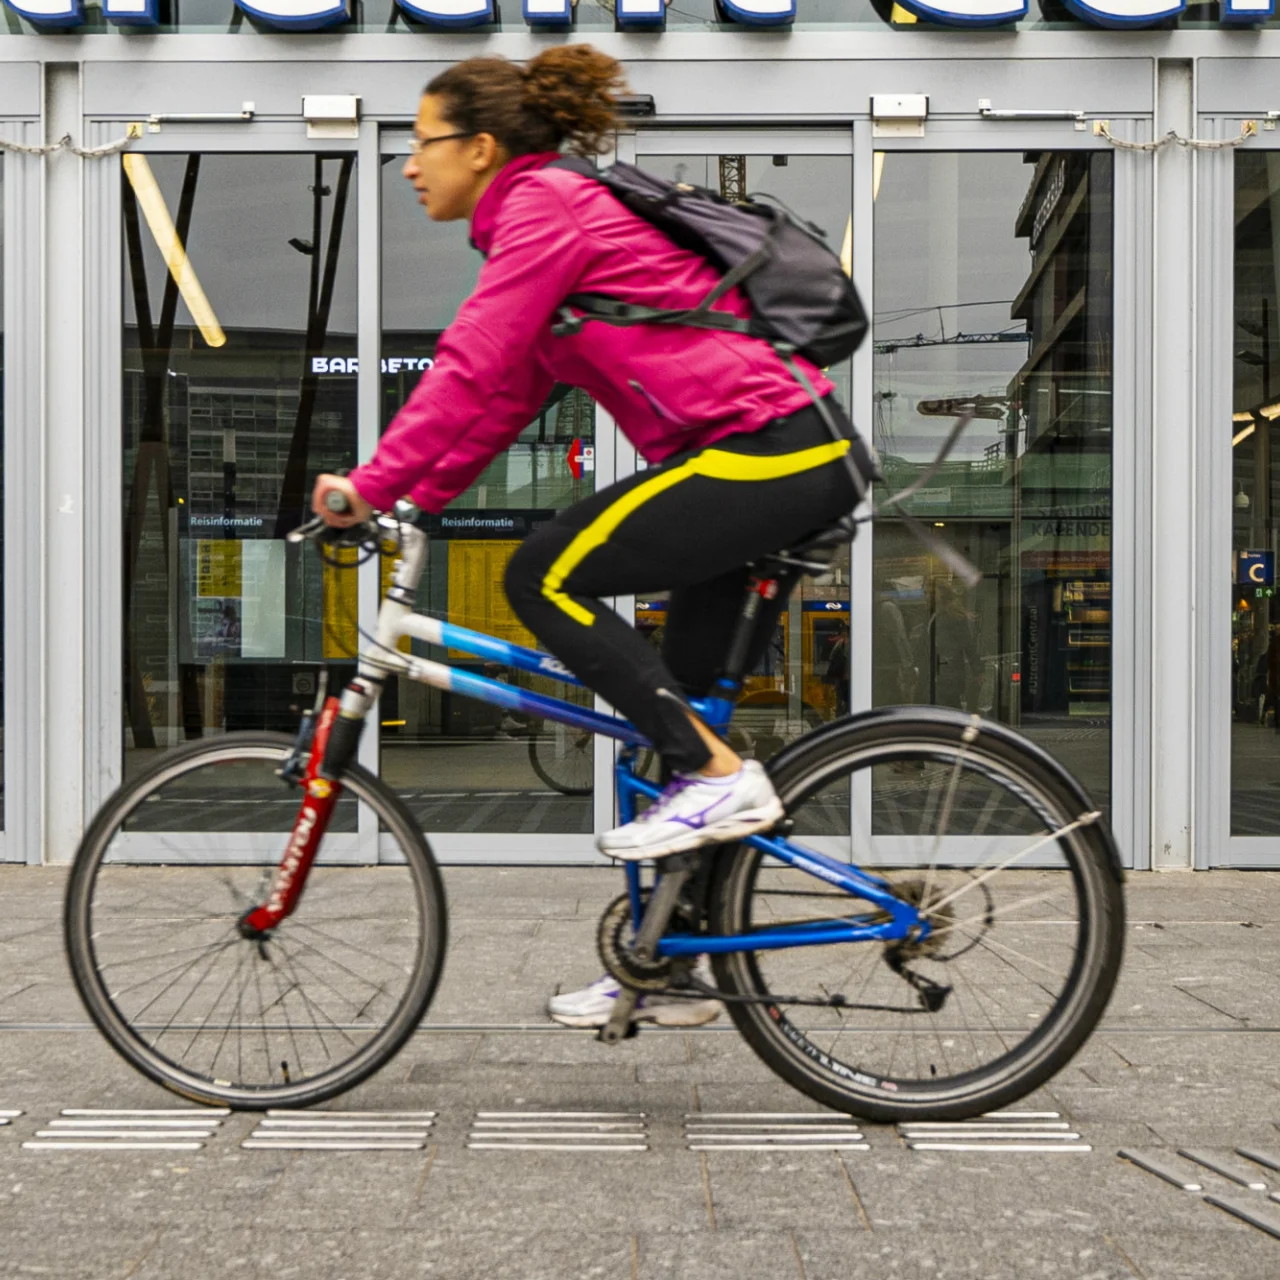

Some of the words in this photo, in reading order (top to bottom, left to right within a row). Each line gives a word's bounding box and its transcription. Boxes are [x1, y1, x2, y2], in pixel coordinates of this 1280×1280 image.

[190, 516, 263, 527] Reisinformatie
[441, 516, 514, 527] Reisinformatie
[1248, 563, 1265, 583] C
